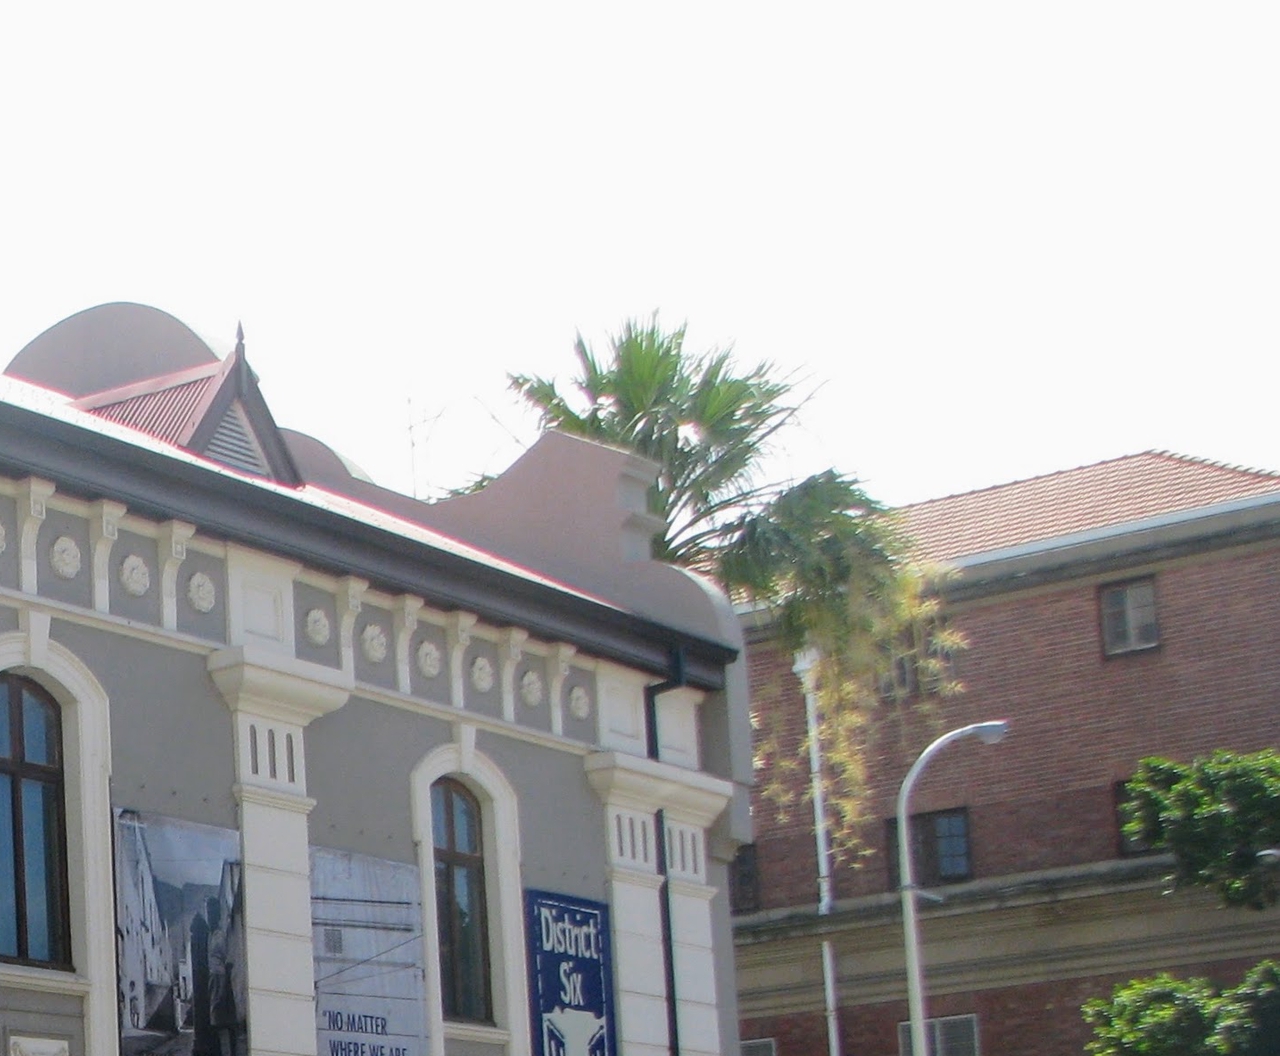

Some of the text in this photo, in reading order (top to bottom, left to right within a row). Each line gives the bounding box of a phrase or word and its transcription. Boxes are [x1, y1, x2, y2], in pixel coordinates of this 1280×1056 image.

[540, 907, 598, 959] District
[559, 961, 584, 1005] Six
[347, 1013, 388, 1036] MATTER
